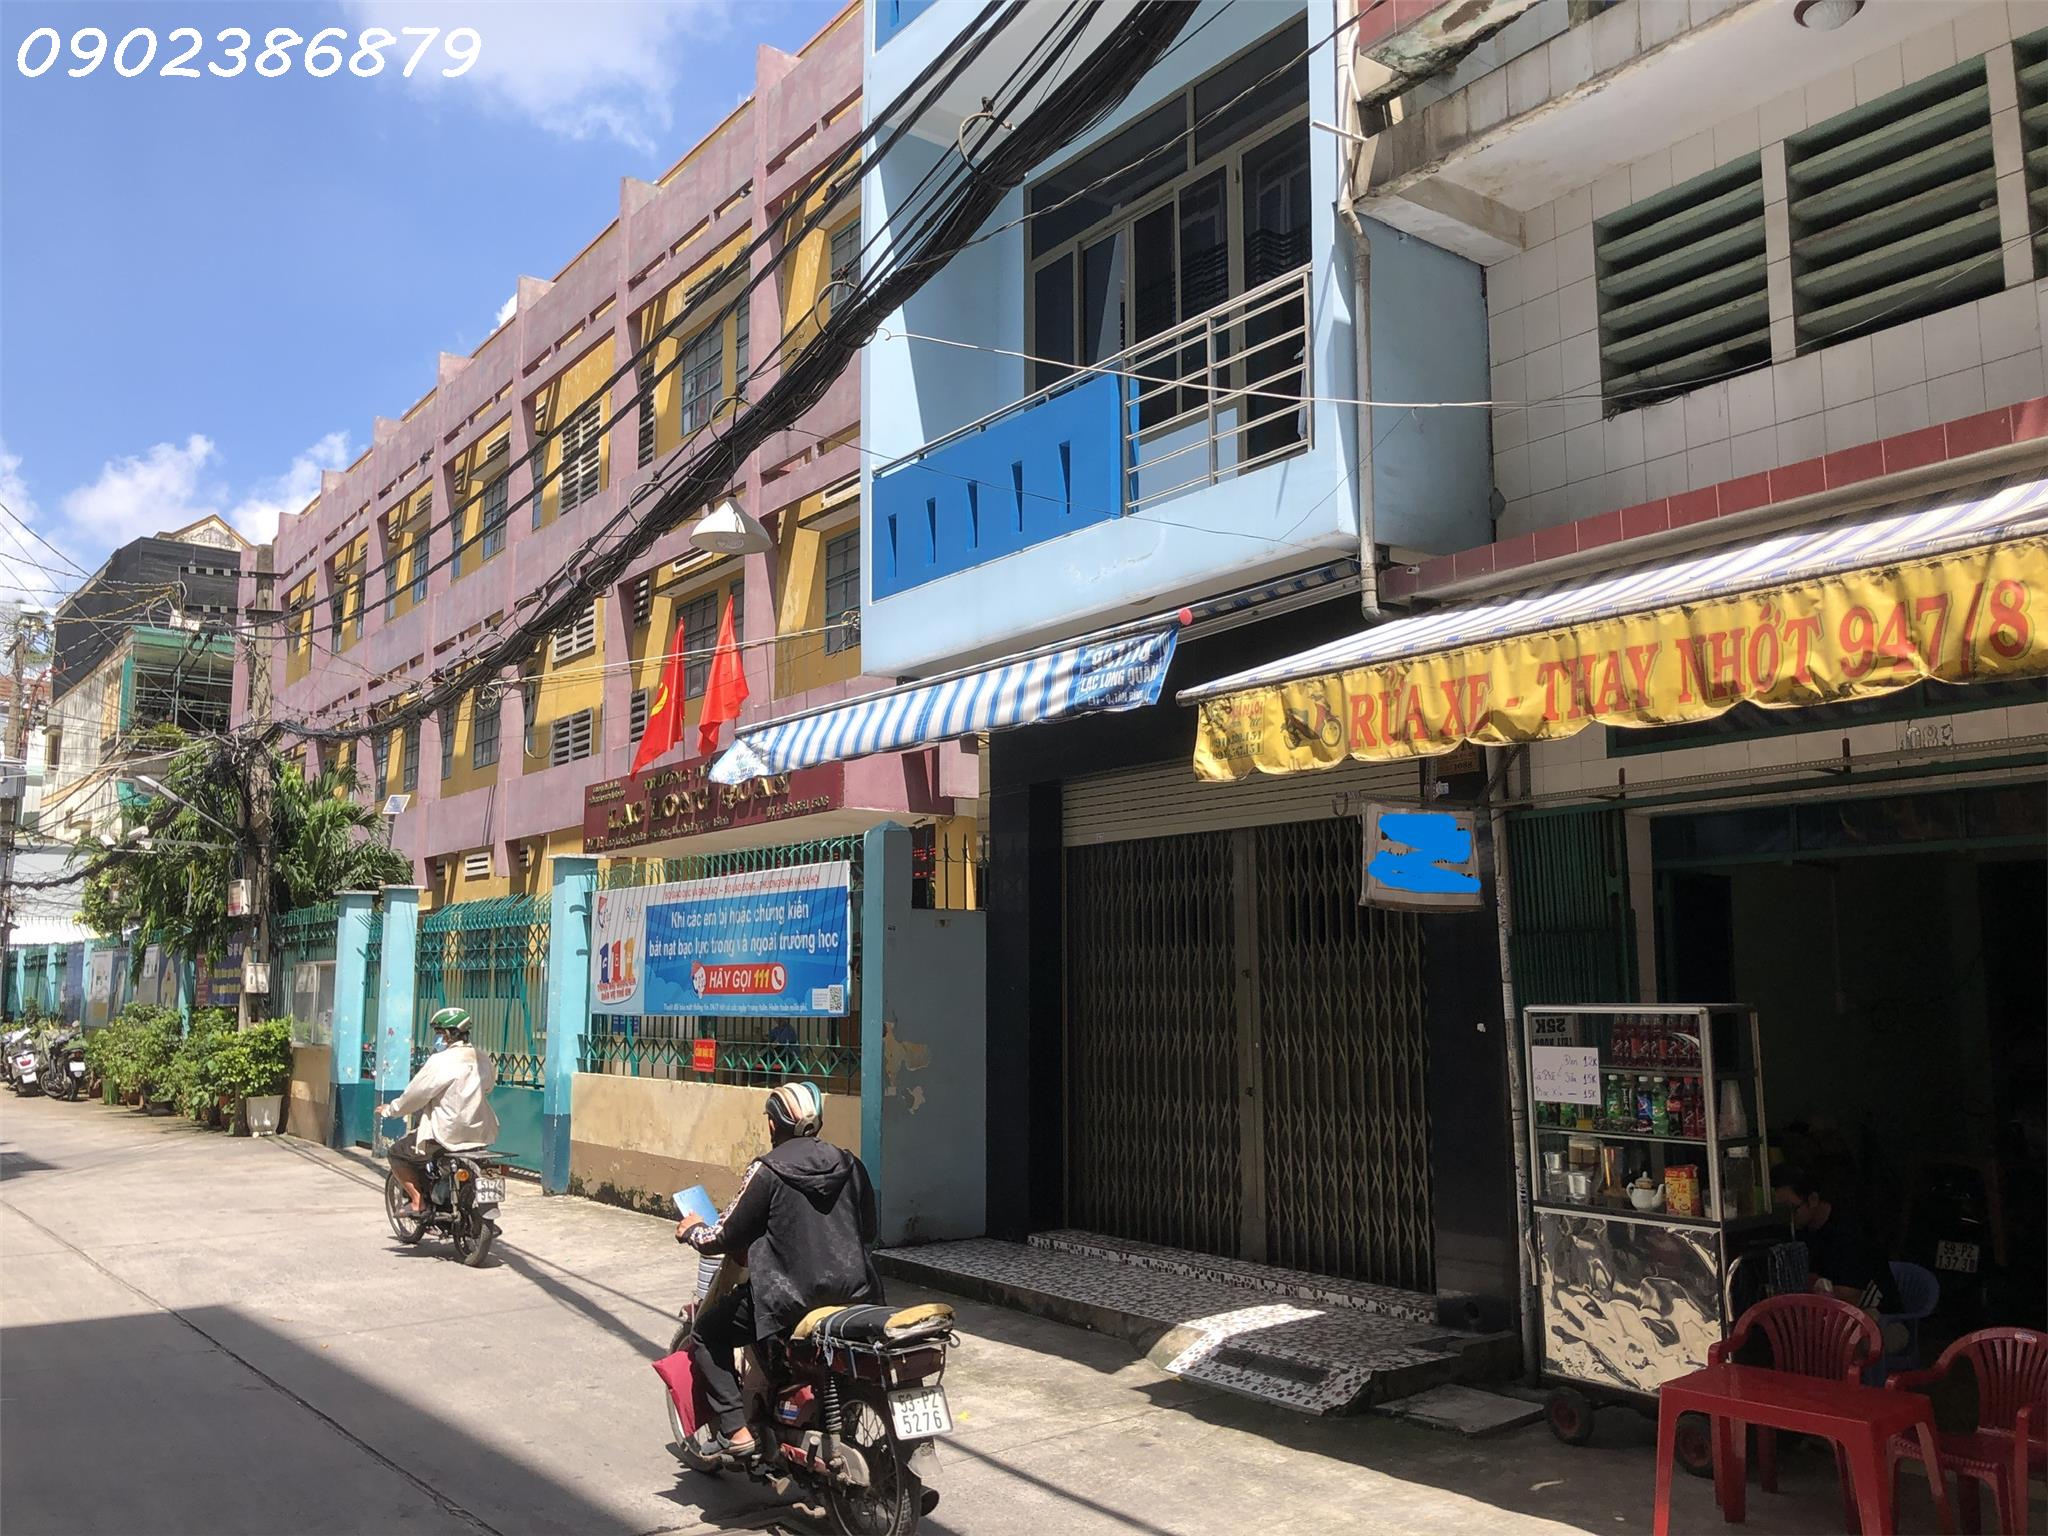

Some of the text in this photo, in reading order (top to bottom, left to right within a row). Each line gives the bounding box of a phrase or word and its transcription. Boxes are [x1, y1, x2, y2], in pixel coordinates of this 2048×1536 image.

[1099, 668, 1125, 688] LONG
[1128, 662, 1160, 686] QUÂN
[1350, 666, 1431, 748] RỬA
[1440, 671, 1492, 736] XE
[1537, 640, 1661, 721] THAY
[1676, 603, 1820, 704] NHỚT
[1839, 579, 2029, 679] 947/8
[651, 784, 710, 822] LONG
[671, 896, 809, 929] Khi các em bị hoặc chứng kiến
[649, 929, 838, 959] bắt nạt bạo lực trong và ngoài trường học
[709, 968, 769, 992] HÃY GỌI 111
[1535, 1018, 1566, 1034] 25K
[1583, 1073, 1598, 1086] 15K
[903, 1410, 942, 1434] 5276
